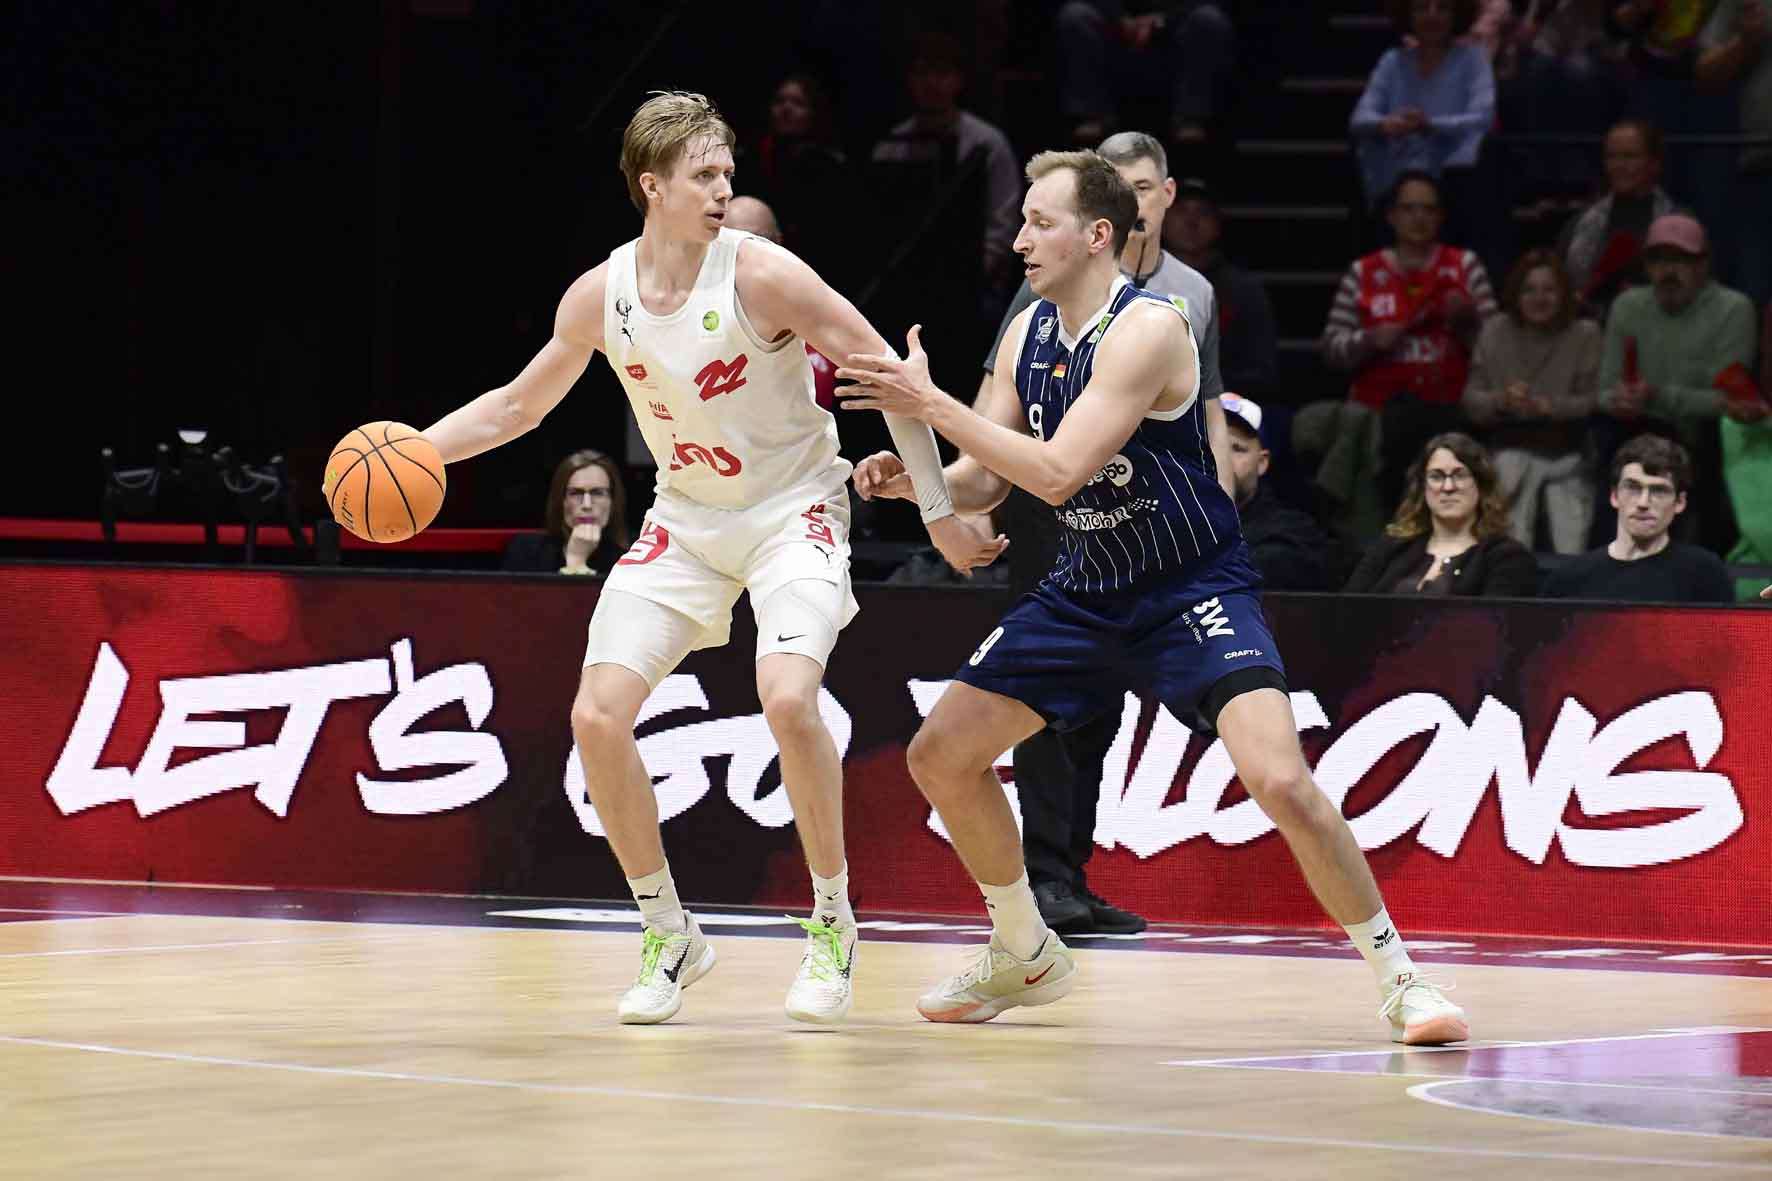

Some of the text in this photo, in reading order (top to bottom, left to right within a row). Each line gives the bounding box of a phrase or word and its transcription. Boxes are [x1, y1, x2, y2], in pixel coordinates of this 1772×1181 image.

[1029, 403, 1044, 440] 9
[968, 626, 1005, 666] 9
[1224, 649, 1255, 660] CRAFT
[45, 637, 509, 818] LET'S
